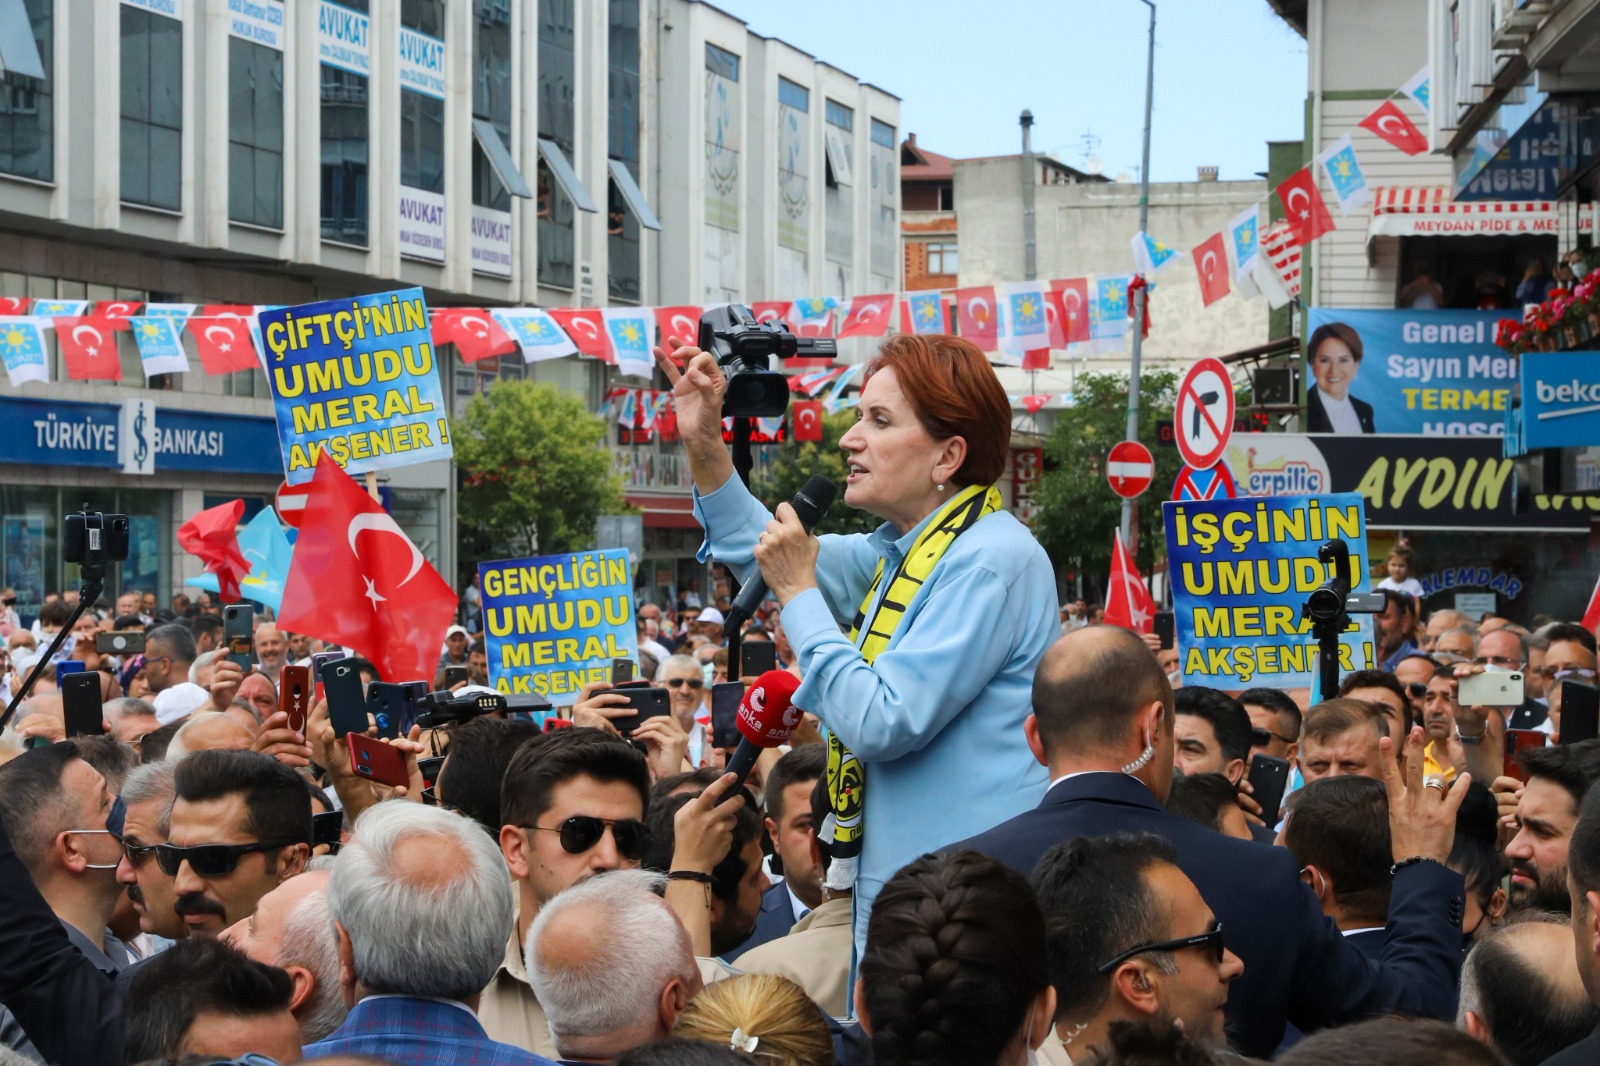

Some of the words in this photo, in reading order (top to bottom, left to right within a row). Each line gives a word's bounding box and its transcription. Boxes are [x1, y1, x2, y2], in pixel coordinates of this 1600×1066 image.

[320, 4, 369, 48] AVUKAT
[401, 31, 443, 72] AVUKAT
[400, 198, 443, 226] AVUKAT
[1414, 220, 1474, 231] MEYDAN
[1480, 218, 1511, 231] PİDE
[1517, 221, 1527, 231] &
[472, 216, 510, 243] AVUKAT
[266, 295, 426, 361] ÇİFTÇİ'NİN
[1403, 321, 1484, 344] Genel
[274, 343, 433, 398] UMUDU
[1387, 354, 1461, 383] Sayın
[291, 386, 433, 434] MERAL
[1402, 388, 1509, 410] TERME
[33, 413, 116, 452] TÜRKİYE
[153, 426, 223, 457] BANKASI
[288, 422, 433, 472] AKŞENER
[437, 418, 449, 444] !
[1353, 456, 1514, 510] AYDIN
[1174, 499, 1361, 554] İŞÇİNİN
[484, 553, 628, 599] GENÇLİĞİN
[1422, 567, 1523, 599] ALEMDAR
[486, 595, 630, 637] UMUDU
[1193, 605, 1360, 638] MER
[501, 634, 629, 668] MERAL
[1362, 641, 1374, 671] !
[738, 703, 763, 730] anka
